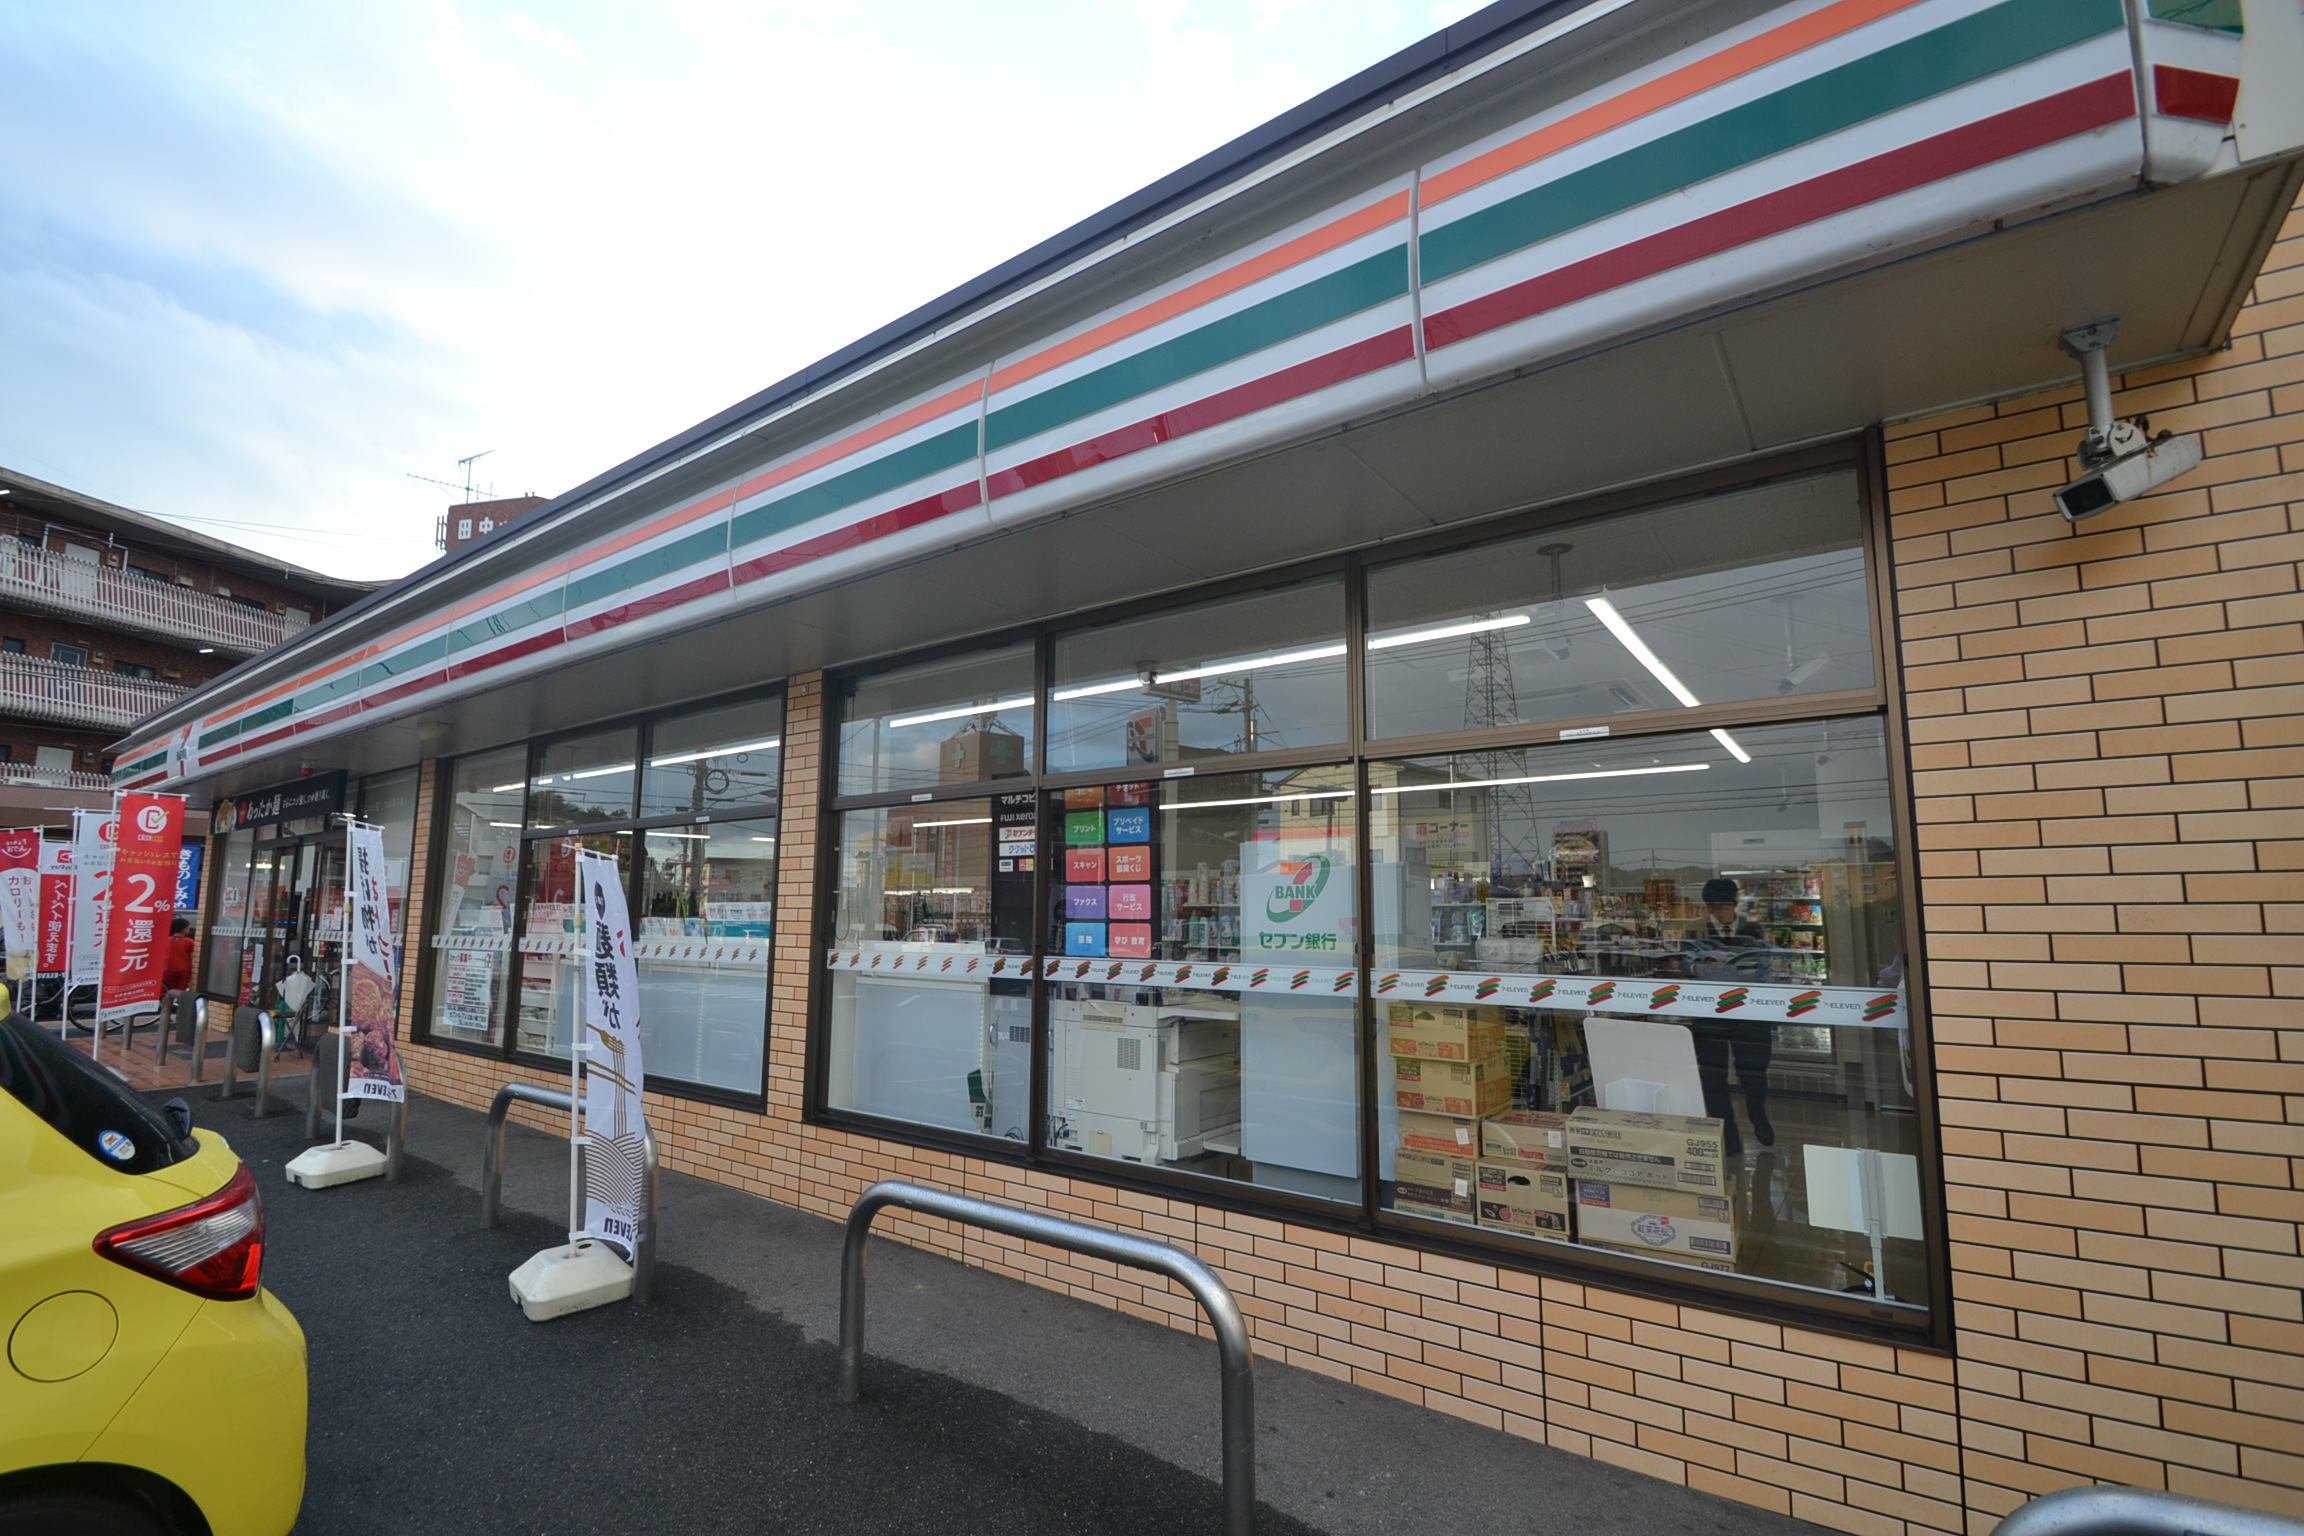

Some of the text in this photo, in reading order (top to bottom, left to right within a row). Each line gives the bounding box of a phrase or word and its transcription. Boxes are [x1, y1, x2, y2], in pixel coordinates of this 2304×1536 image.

[1000, 814, 1014, 822] FUJI
[1113, 817, 1144, 826] プリペイド
[1013, 828, 1036, 838] セブンチ
[1073, 825, 1096, 833] プリント
[1116, 826, 1142, 834] サービス
[121, 848, 178, 858] キャッシュレスで
[1116, 855, 1141, 863] スポーツ
[1073, 861, 1097, 869] スキャン
[1275, 885, 1318, 899] BANK
[1073, 898, 1097, 906] ファクス
[1116, 902, 1142, 911] サービス
[8, 875, 26, 943] カロリーも！
[1114, 936, 1127, 945] 学び
[1259, 931, 1338, 951] セブン銀行
[119, 918, 155, 973] 還元
[1686, 1138, 1718, 1149] GJ955
